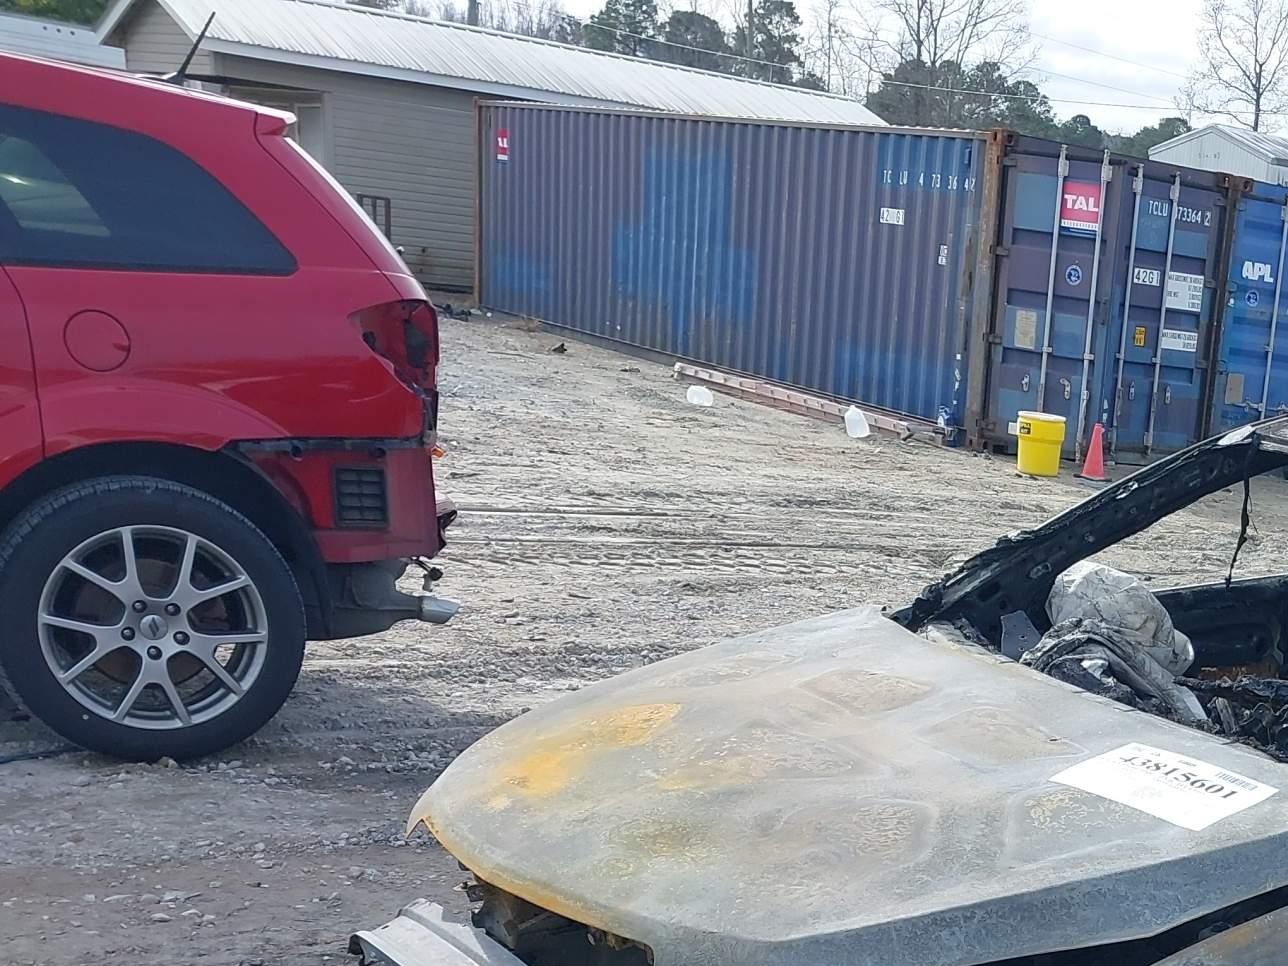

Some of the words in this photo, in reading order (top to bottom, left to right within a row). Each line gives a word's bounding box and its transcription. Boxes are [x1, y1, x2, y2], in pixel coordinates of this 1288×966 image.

[1063, 194, 1099, 212] TAL
[1148, 200, 1169, 217] TCLU
[1135, 269, 1160, 286] 42G1
[1242, 260, 1274, 283] APL
[1119, 756, 1238, 799] 43815601
